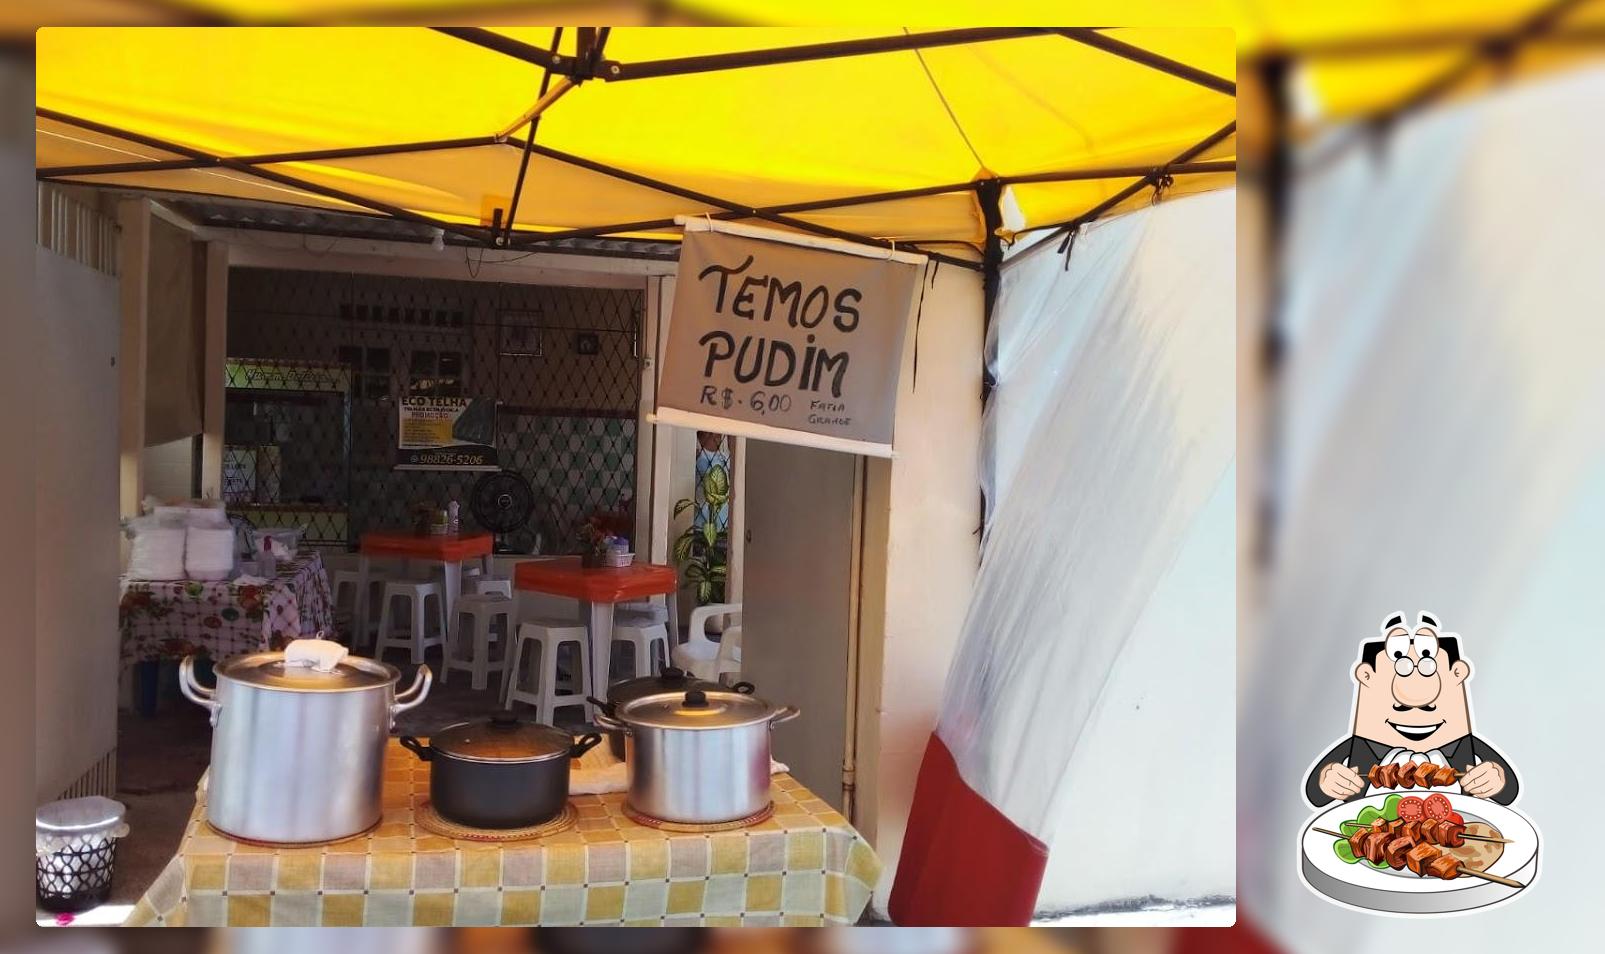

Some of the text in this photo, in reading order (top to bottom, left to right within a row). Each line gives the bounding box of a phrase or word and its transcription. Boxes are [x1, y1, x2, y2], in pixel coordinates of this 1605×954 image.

[699, 255, 862, 333] TEMOS
[402, 396, 467, 407] ECO TELHA
[420, 455, 484, 465] 98826-5206
